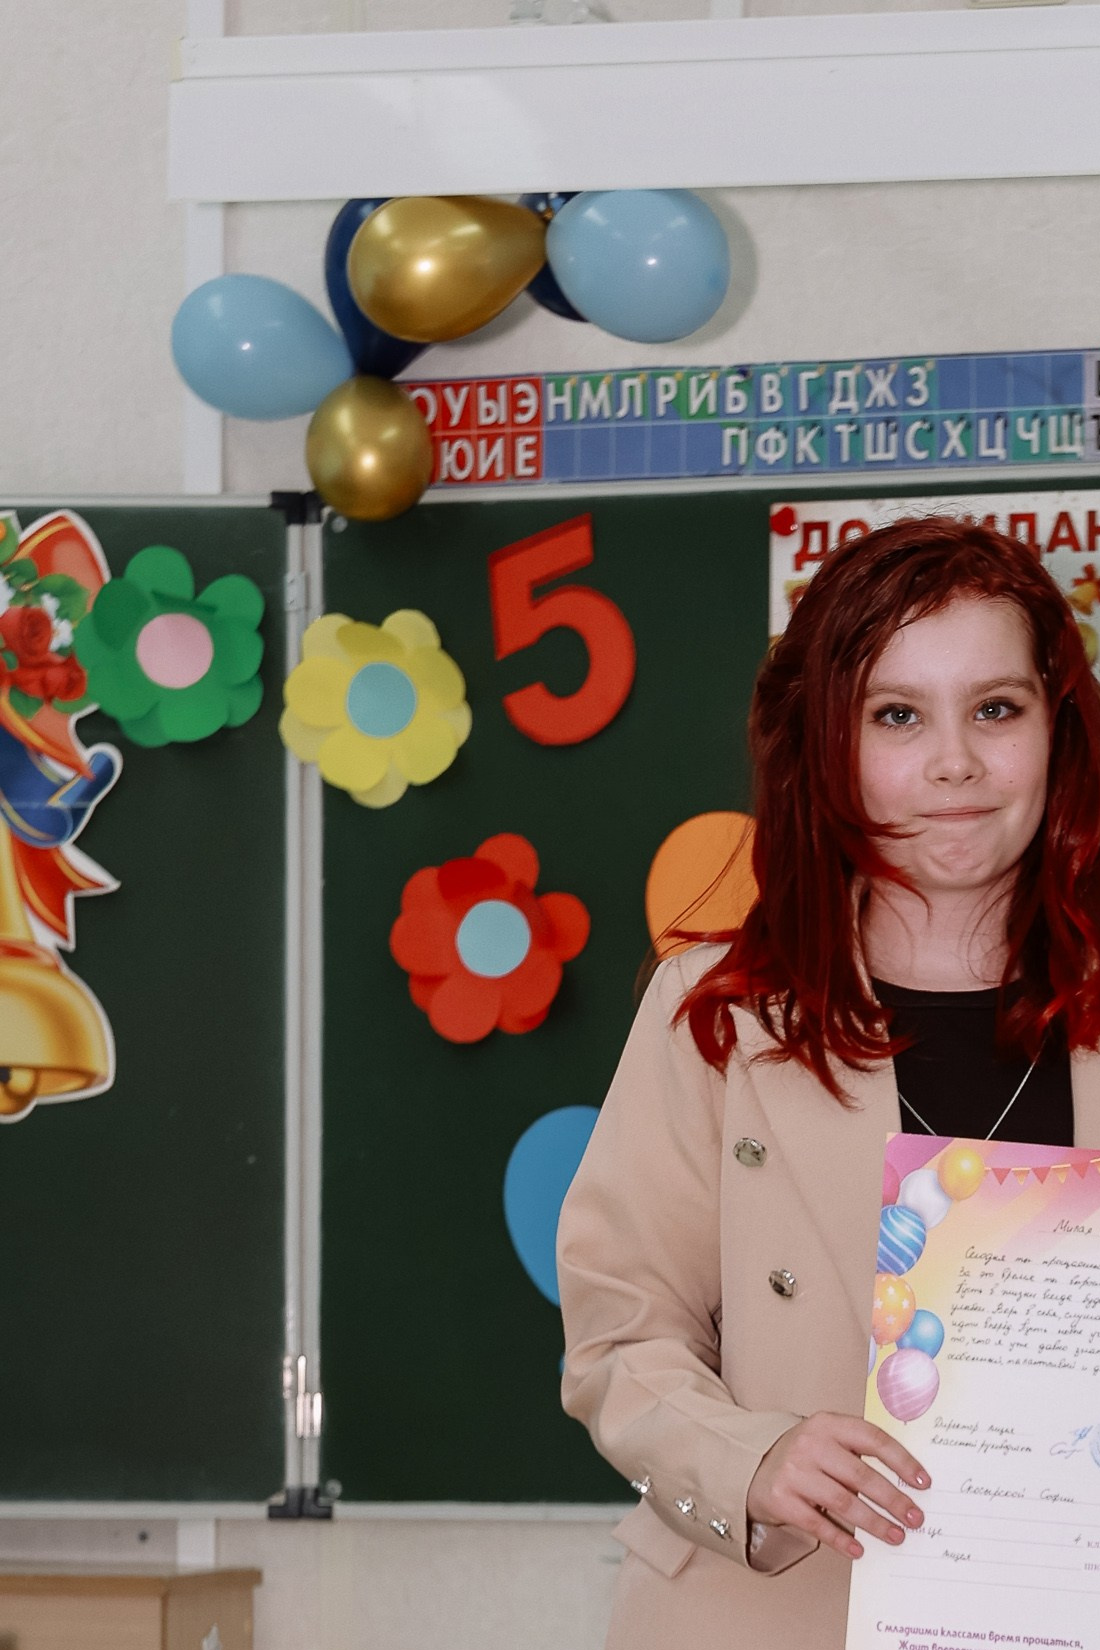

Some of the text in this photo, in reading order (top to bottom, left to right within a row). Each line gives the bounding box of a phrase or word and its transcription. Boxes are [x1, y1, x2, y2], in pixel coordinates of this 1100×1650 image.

[488, 512, 637, 746] 5
[1053, 1219, 1093, 1235] Милая
[964, 1246, 1006, 1265] Сегодня
[959, 1266, 971, 1278] За
[980, 1269, 995, 1278] это
[1001, 1267, 1035, 1282] время
[1002, 1290, 1037, 1302] жизни
[934, 1416, 979, 1435] Директор
[1040, 1488, 1075, 1504] Софии
[876, 1621, 1084, 1650] С младшими классами время прощаться,
